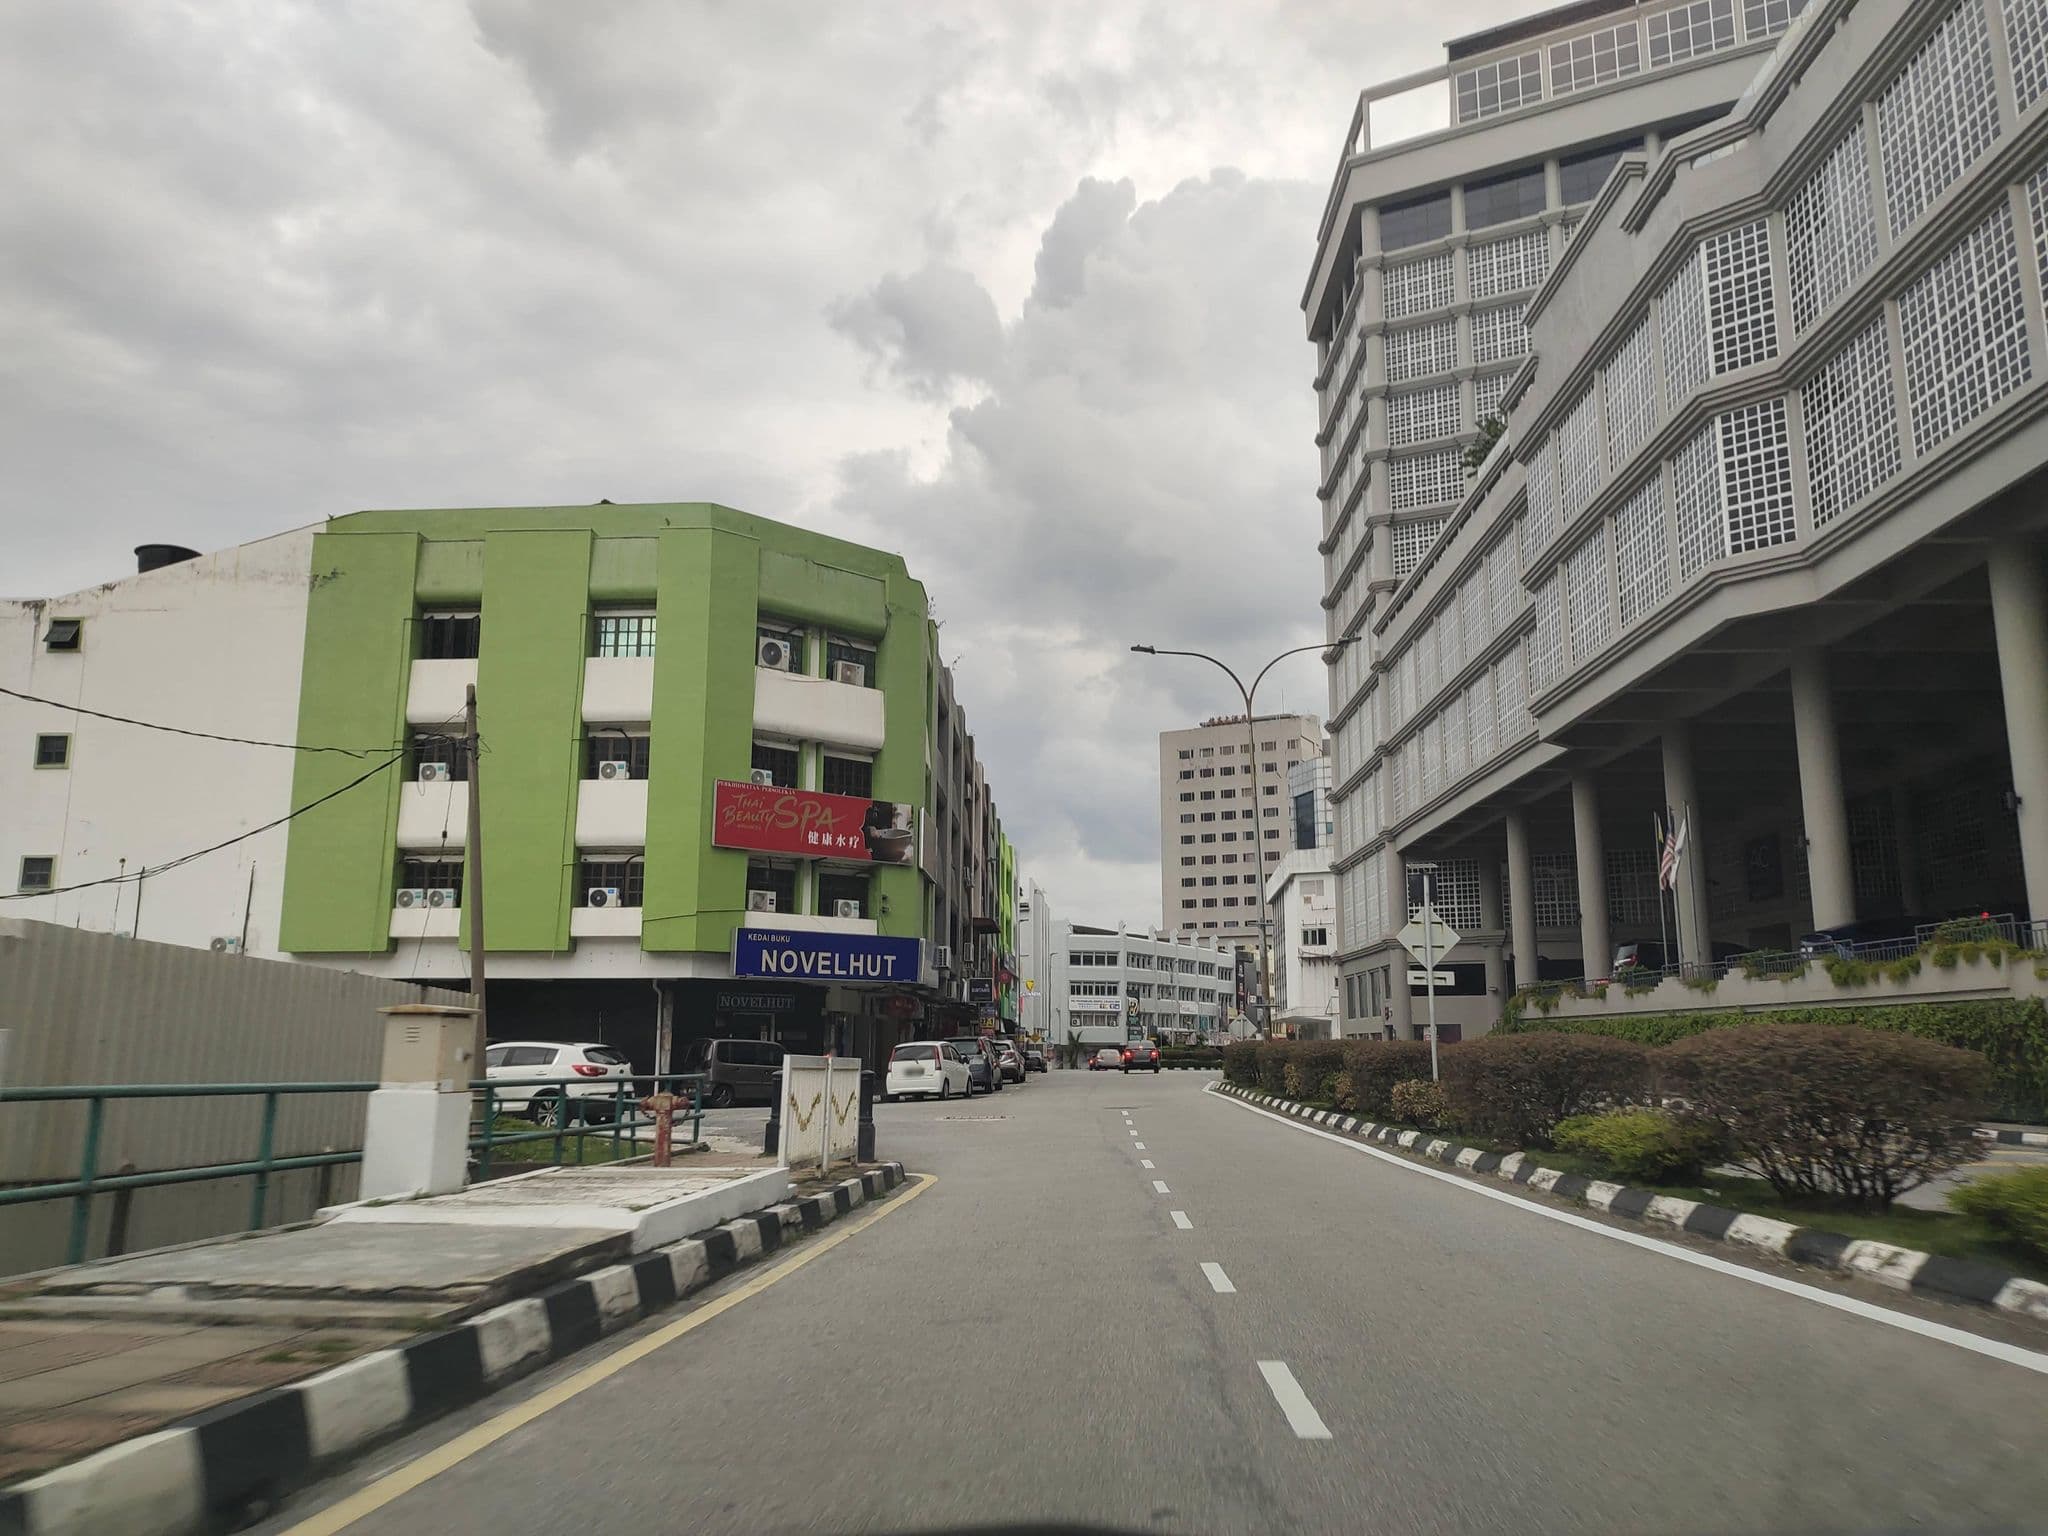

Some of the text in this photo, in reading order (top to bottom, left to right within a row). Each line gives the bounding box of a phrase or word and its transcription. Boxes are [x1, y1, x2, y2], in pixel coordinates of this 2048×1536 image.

[731, 794, 765, 808] THAI
[723, 805, 777, 832] BEAUTY
[774, 796, 848, 842] SPA
[808, 830, 860, 849] 健康水疗
[747, 933, 791, 943] KEDAI BUKU
[761, 949, 897, 977] NOVELHUT
[719, 995, 793, 1009] NOVELHUT
